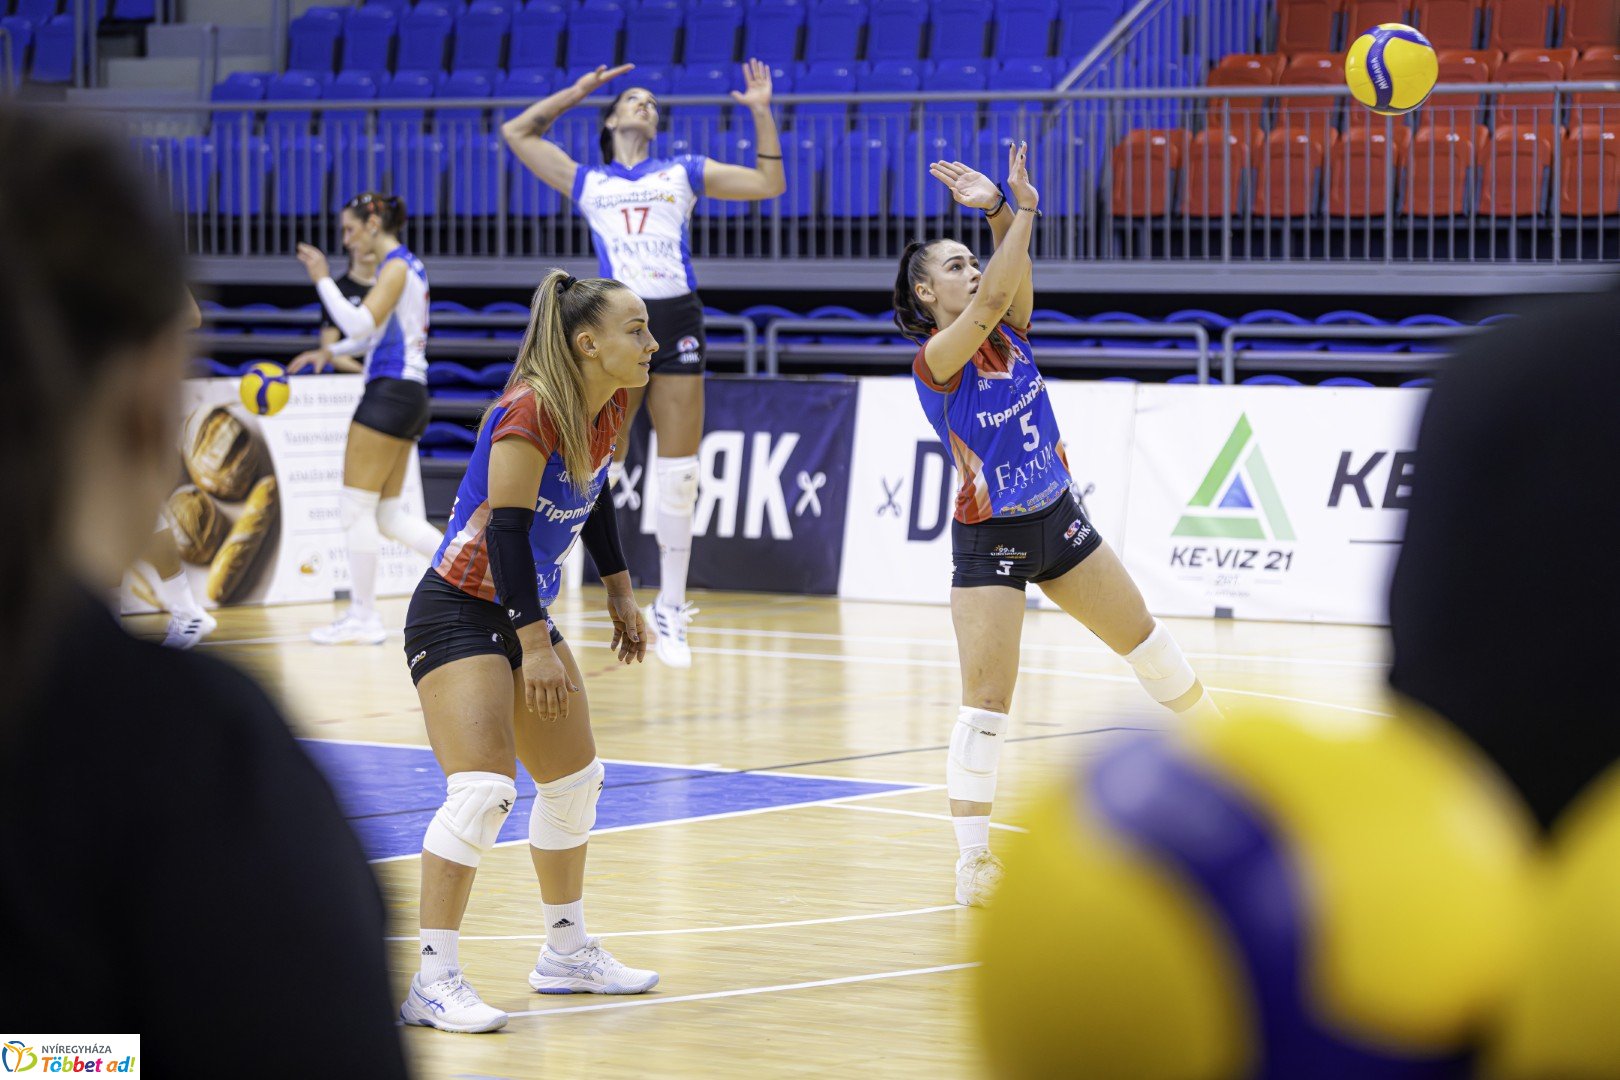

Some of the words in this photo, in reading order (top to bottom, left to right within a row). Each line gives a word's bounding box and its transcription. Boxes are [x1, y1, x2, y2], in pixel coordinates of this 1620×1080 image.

[621, 206, 650, 234] 17
[1019, 409, 1041, 452] 5
[1327, 450, 1416, 510] KE
[554, 521, 587, 565] 7
[1170, 547, 1258, 569] KE-VIZ
[1264, 550, 1294, 571] 21
